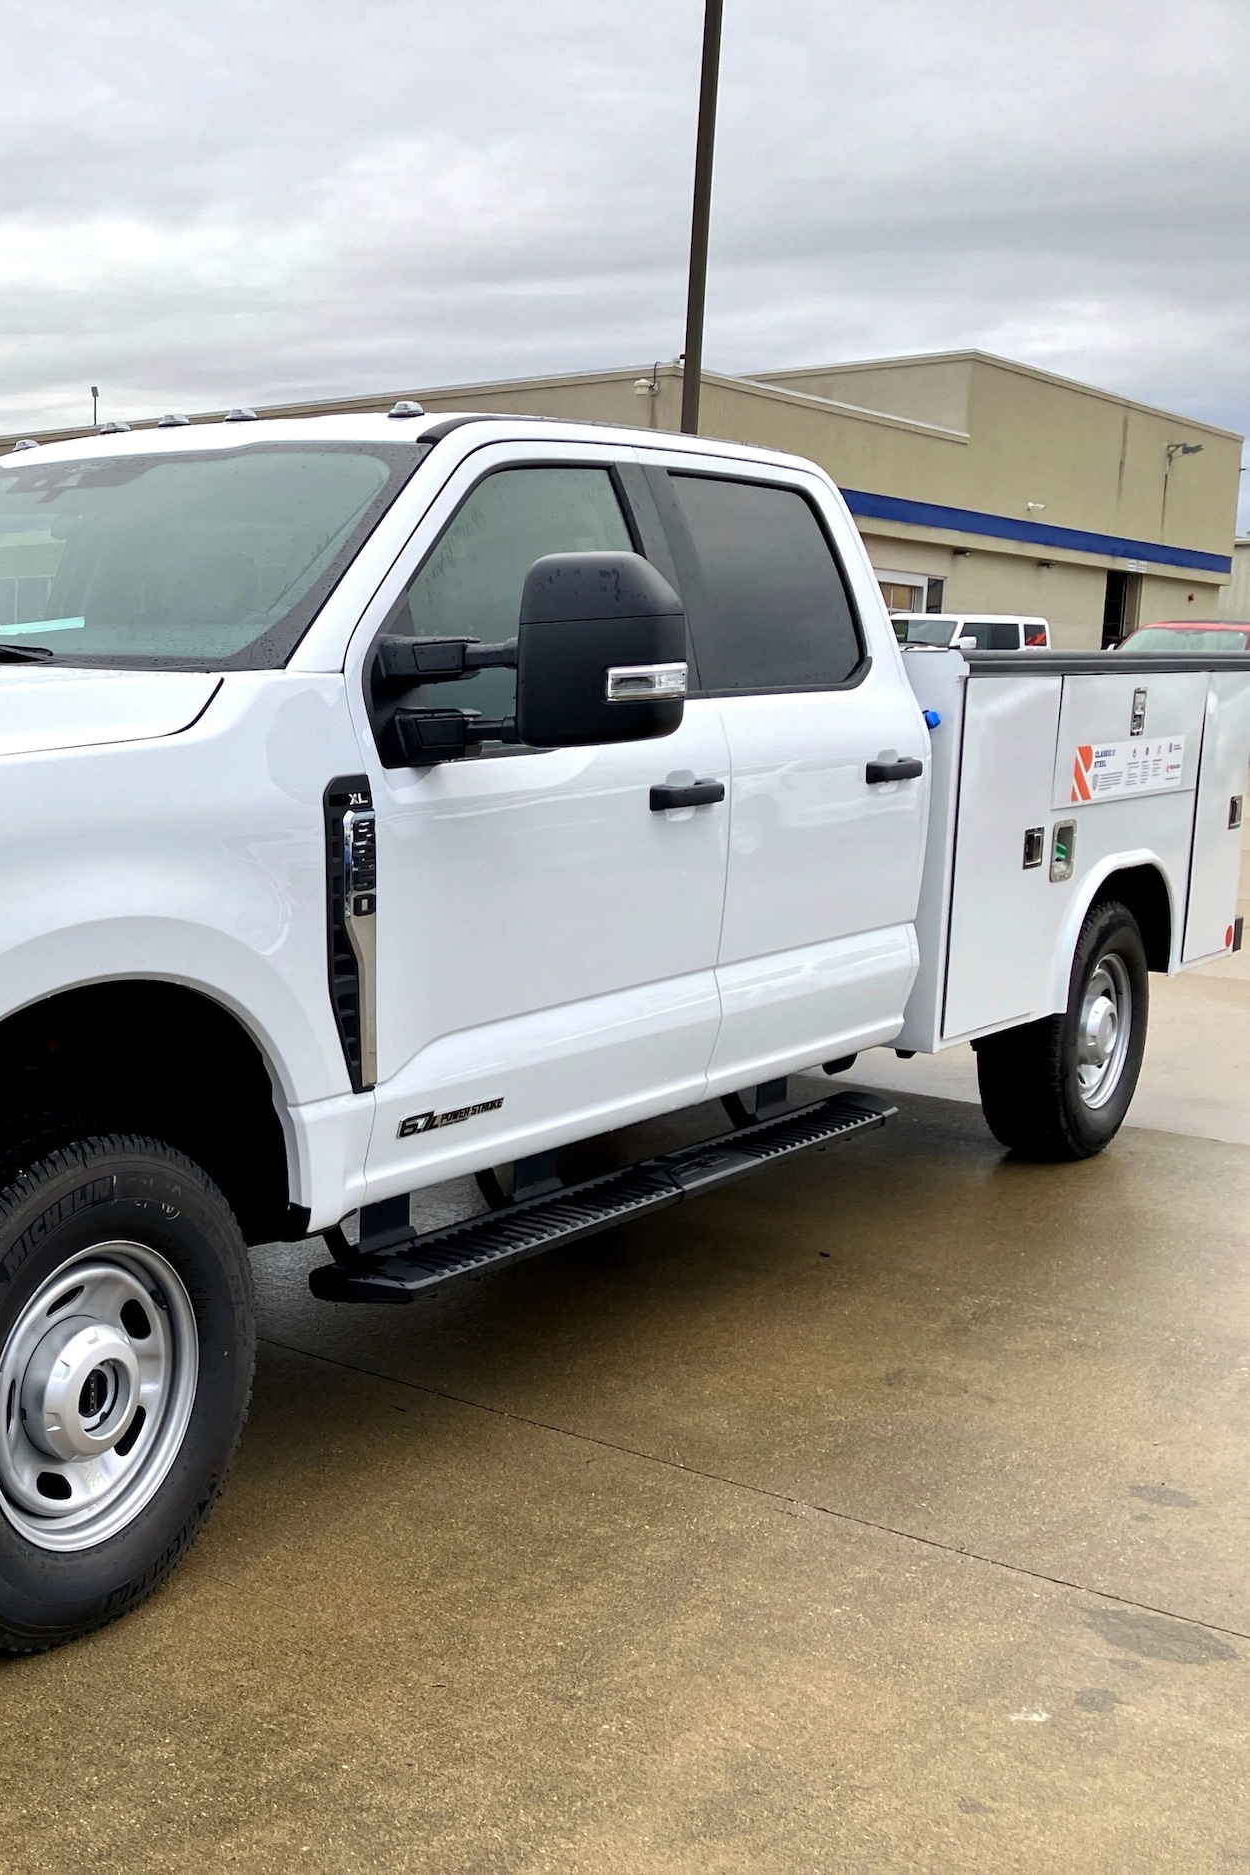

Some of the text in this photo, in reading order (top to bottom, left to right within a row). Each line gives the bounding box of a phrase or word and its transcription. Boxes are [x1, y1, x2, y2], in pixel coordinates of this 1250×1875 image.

[348, 793, 368, 805] XL
[396, 1097, 504, 1139] 6.7L POWER STROKE
[3, 1175, 114, 1276] MICHELIN
